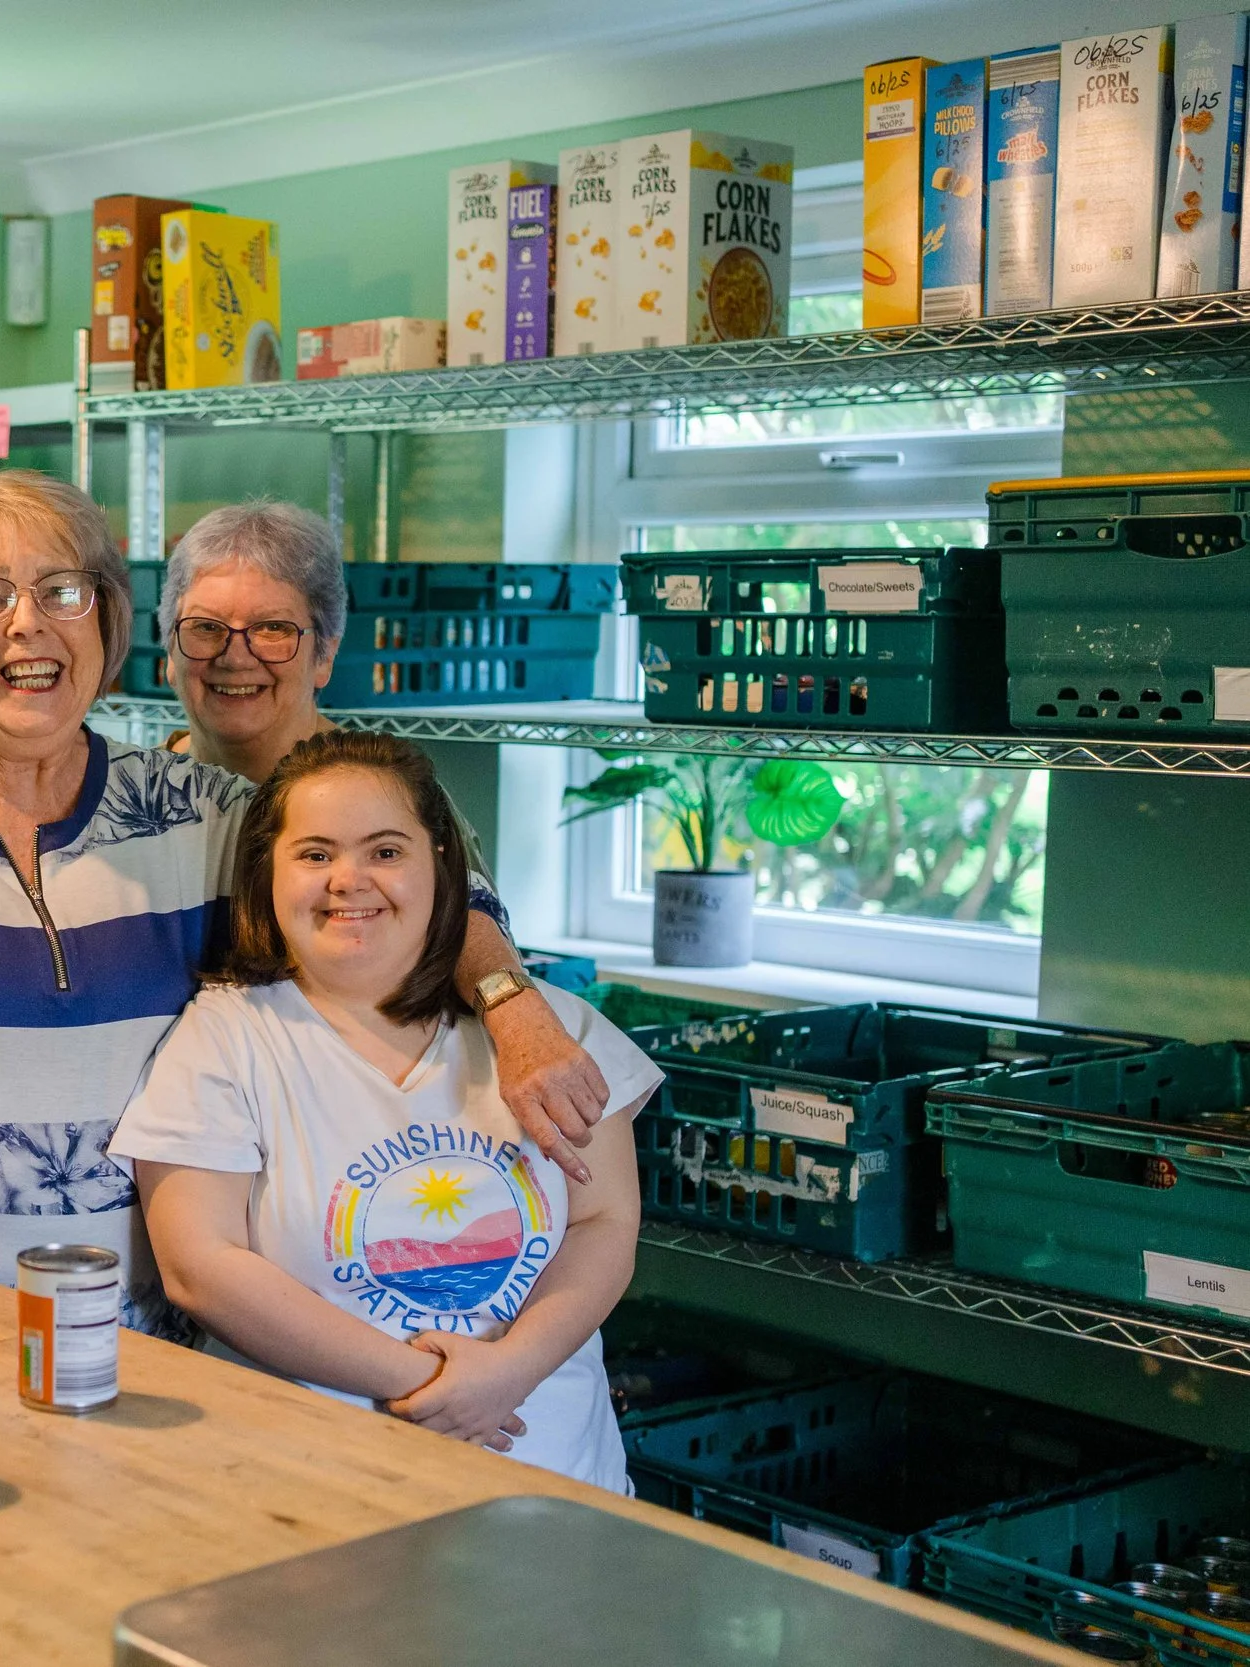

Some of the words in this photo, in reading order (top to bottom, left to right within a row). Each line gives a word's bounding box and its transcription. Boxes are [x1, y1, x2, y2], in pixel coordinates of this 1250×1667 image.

[1073, 34, 1149, 66] 06/25
[870, 70, 911, 98] 06/25
[1086, 71, 1130, 90] CORN
[1000, 80, 1041, 107] 6/25
[1077, 87, 1140, 112] FLAKES
[1181, 87, 1222, 118] 6/25
[879, 119, 903, 129] HOOPS
[936, 110, 951, 121] MILK
[953, 105, 974, 118] CHOCO
[934, 117, 976, 136] PILLOWS
[575, 176, 605, 192] CORN
[638, 165, 670, 182] CORN
[569, 188, 612, 208] FLAKES
[632, 178, 676, 200] FLAKES
[715, 179, 771, 218] CORN
[463, 194, 492, 209] CORN
[457, 205, 498, 224] FLAKES
[702, 212, 781, 255] FLAKES
[828, 581, 915, 594] Chocolate/Sweets
[760, 1094, 845, 1123] Juice/Squash
[346, 1123, 521, 1190] SUNSHINE
[333, 1261, 427, 1334] STATE
[434, 1311, 480, 1334] OF
[488, 1235, 550, 1322] MIND
[1187, 1275, 1226, 1293] Lentils
[818, 1548, 853, 1570] Soup
